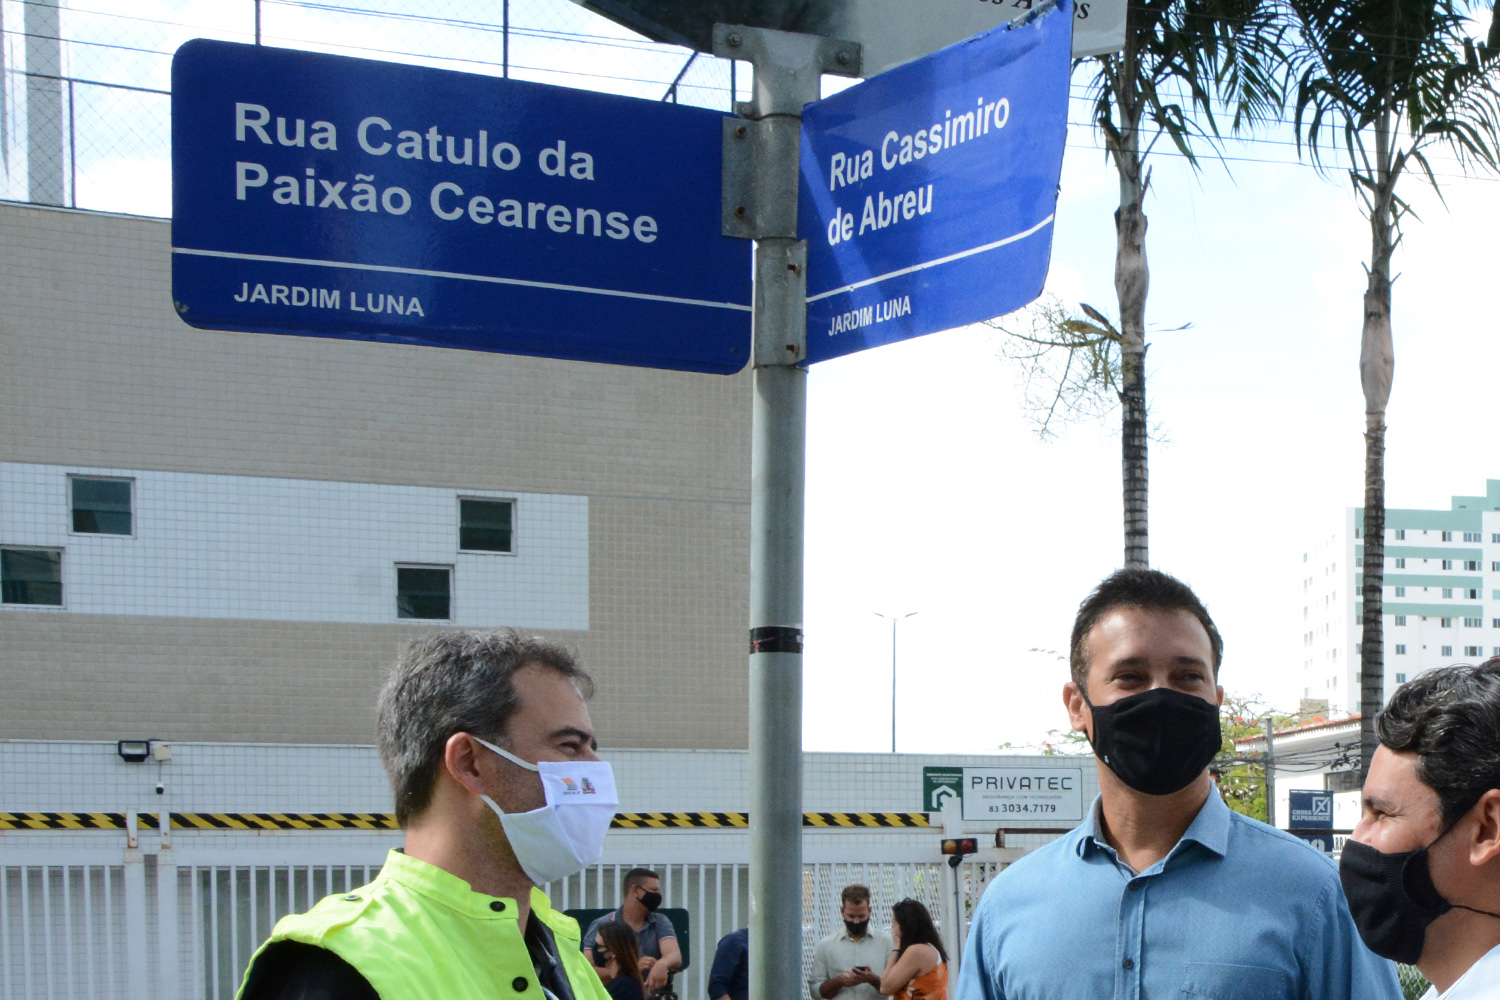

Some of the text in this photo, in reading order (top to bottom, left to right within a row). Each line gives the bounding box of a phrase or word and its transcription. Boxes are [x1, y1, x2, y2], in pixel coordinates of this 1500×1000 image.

[235, 102, 595, 181] Rua Catulo da
[830, 96, 1010, 191] Rua Cassimiro
[235, 161, 658, 243] Paixão Cearense
[827, 184, 933, 246] de Abreu
[233, 282, 425, 317] JARDIM LUNA
[828, 295, 912, 337] JARDIM LUNA
[971, 776, 1073, 790] PRIVATEC
[1001, 804, 1056, 813] 3034.7179
